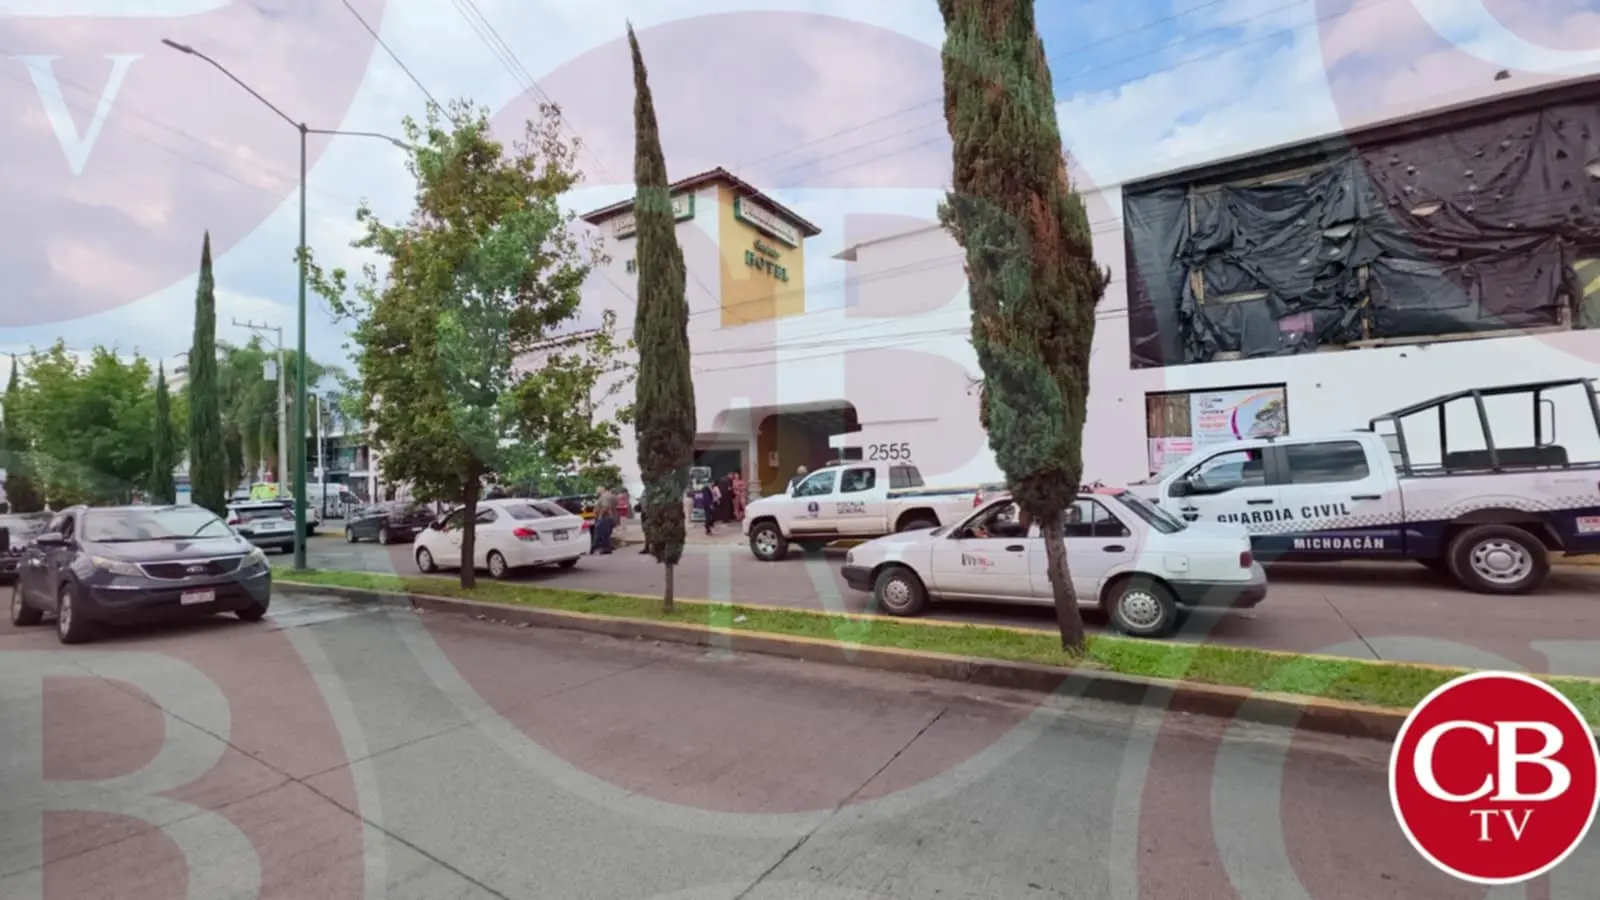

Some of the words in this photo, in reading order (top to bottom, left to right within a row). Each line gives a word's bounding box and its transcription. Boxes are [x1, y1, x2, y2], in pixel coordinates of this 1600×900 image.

[744, 249, 790, 283] HOTEL
[868, 442, 911, 461] 2555
[1301, 501, 1352, 519] CIVIL
[1294, 535, 1385, 550] MICHOACÁN
